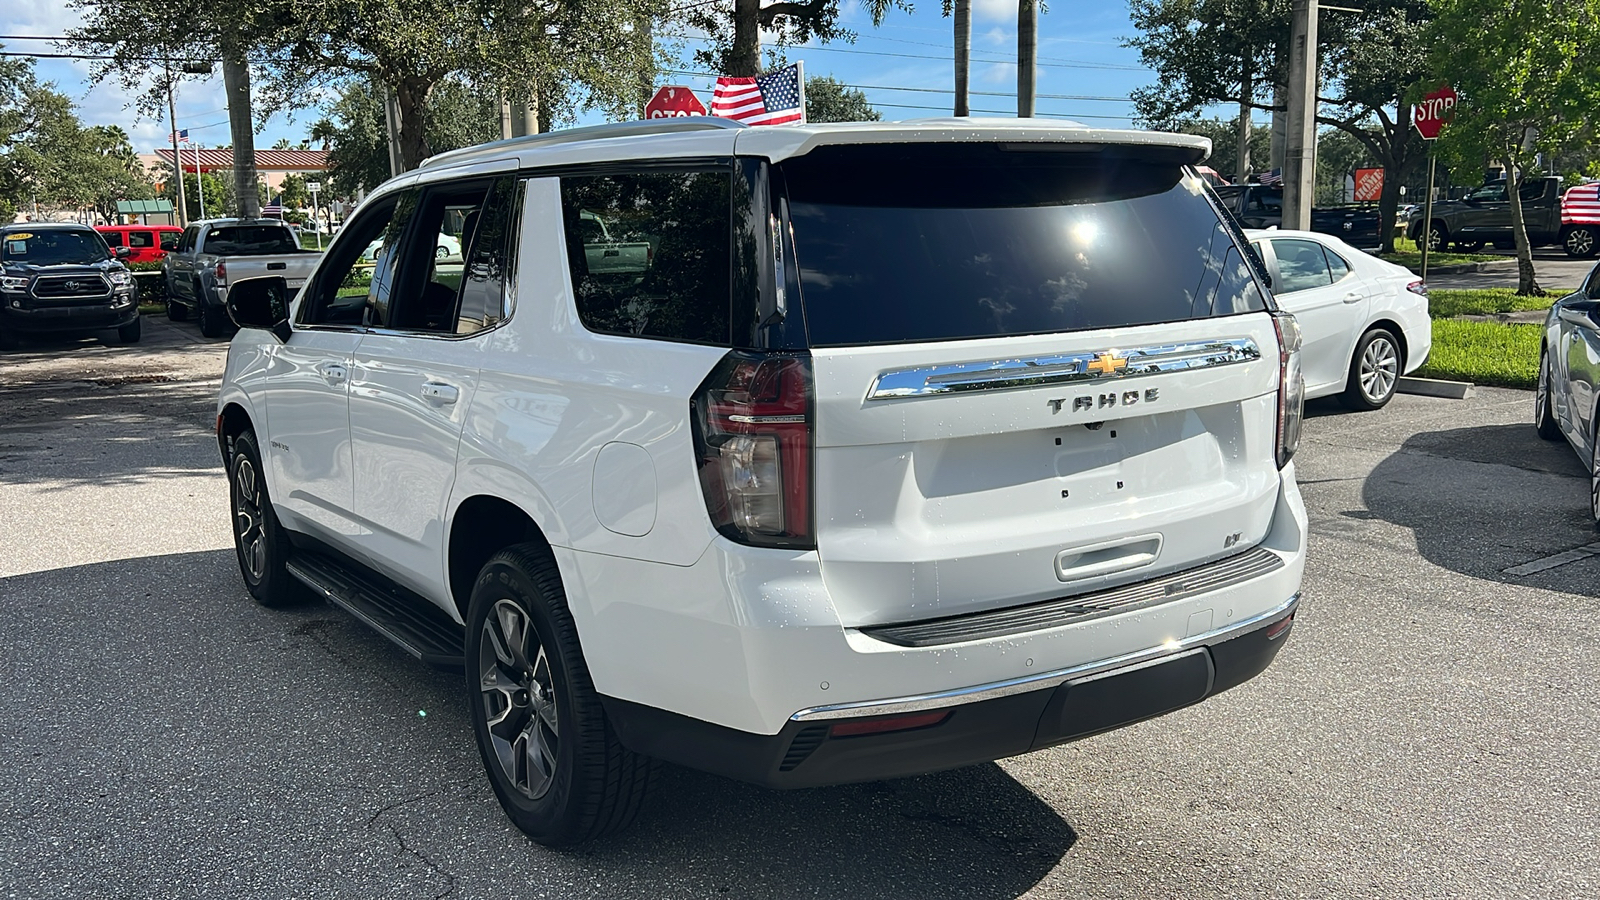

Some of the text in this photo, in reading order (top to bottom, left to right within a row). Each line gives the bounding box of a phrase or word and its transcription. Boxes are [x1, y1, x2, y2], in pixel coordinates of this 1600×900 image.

[1417, 97, 1454, 121] STOP
[1355, 169, 1383, 200] HOME
[1359, 173, 1370, 185] THE
[1366, 181, 1383, 200] DEPOT
[1047, 387, 1159, 415] TAHOE
